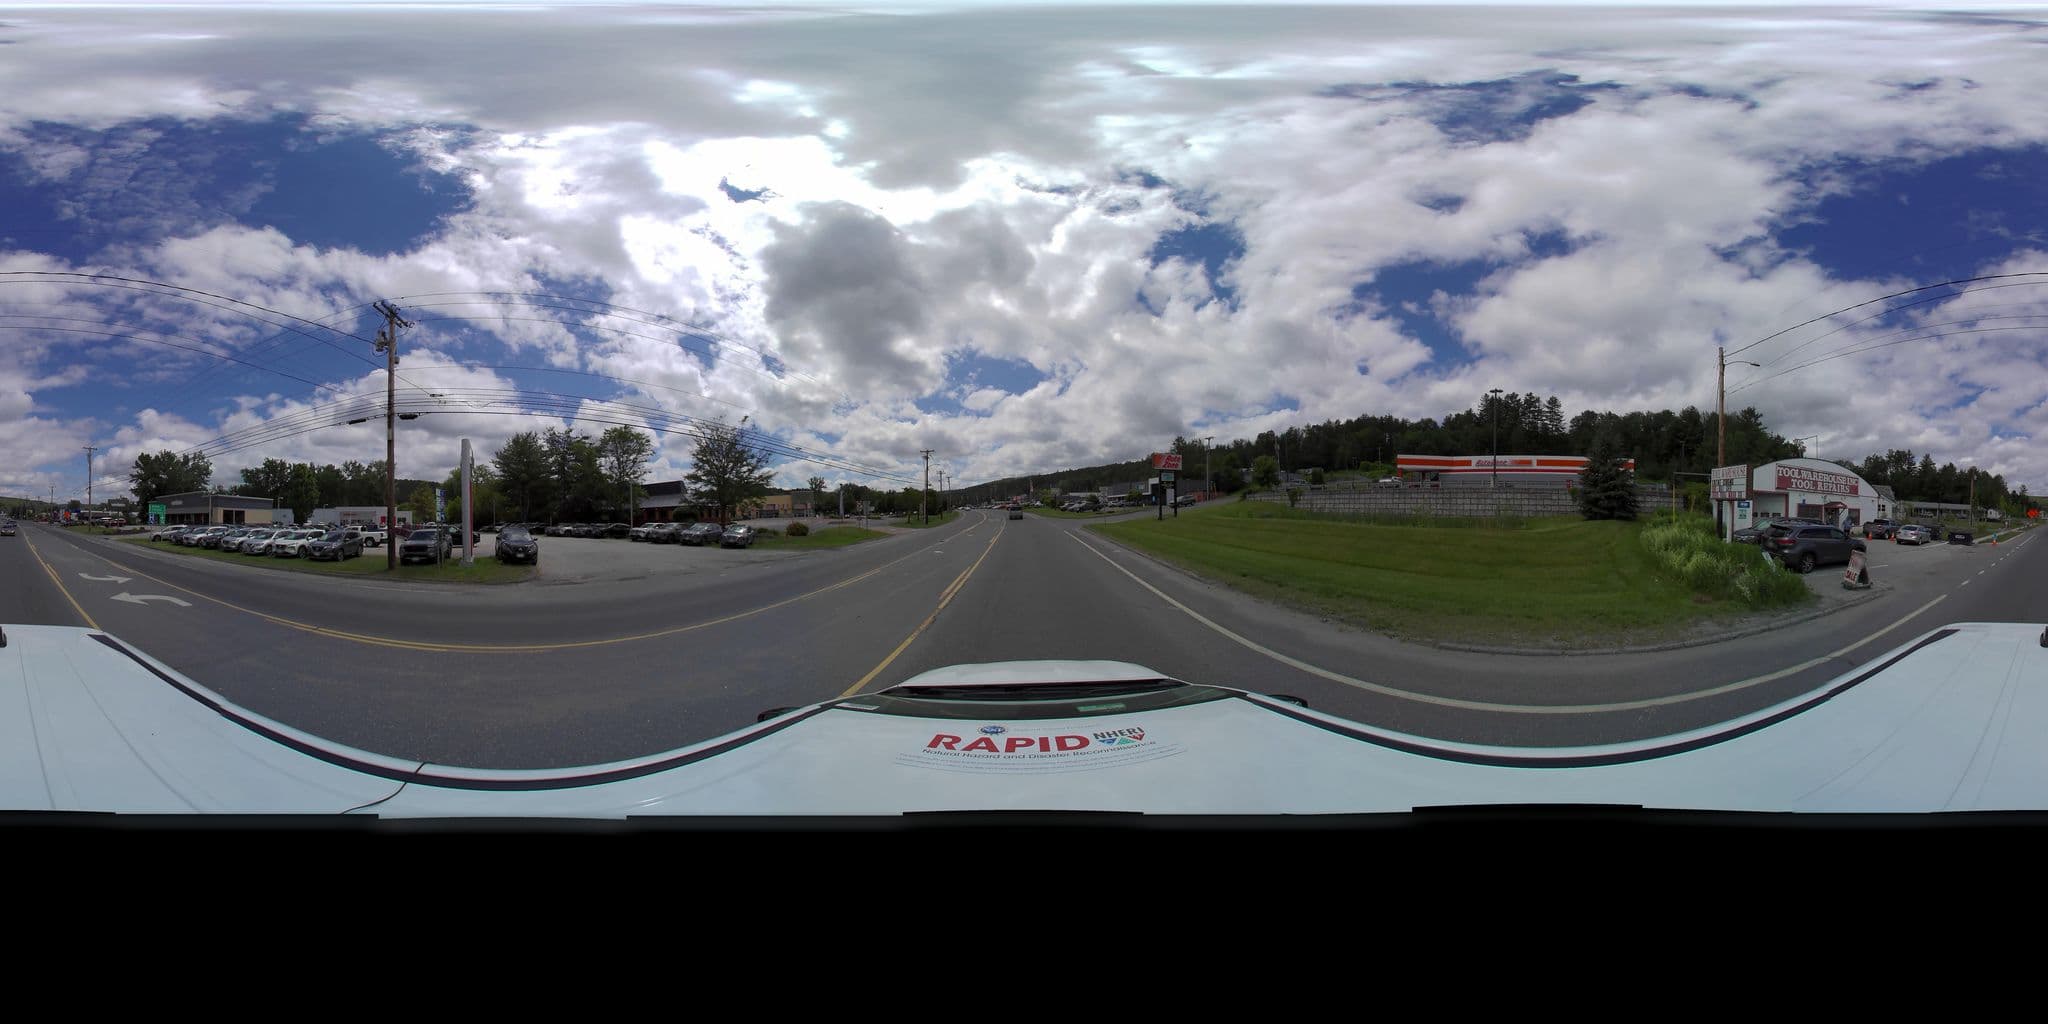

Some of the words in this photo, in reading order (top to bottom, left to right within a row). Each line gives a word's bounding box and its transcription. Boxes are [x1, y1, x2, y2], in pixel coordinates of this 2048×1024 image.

[1776, 467, 1801, 478] TOOL
[1801, 470, 1846, 485] WAREHOUSE
[1791, 479, 1815, 490] TOOL
[1817, 482, 1850, 493] REPAIRS
[1093, 727, 1144, 740] NHERI
[927, 734, 1090, 753] RAPID
[923, 749, 960, 758] Natural
